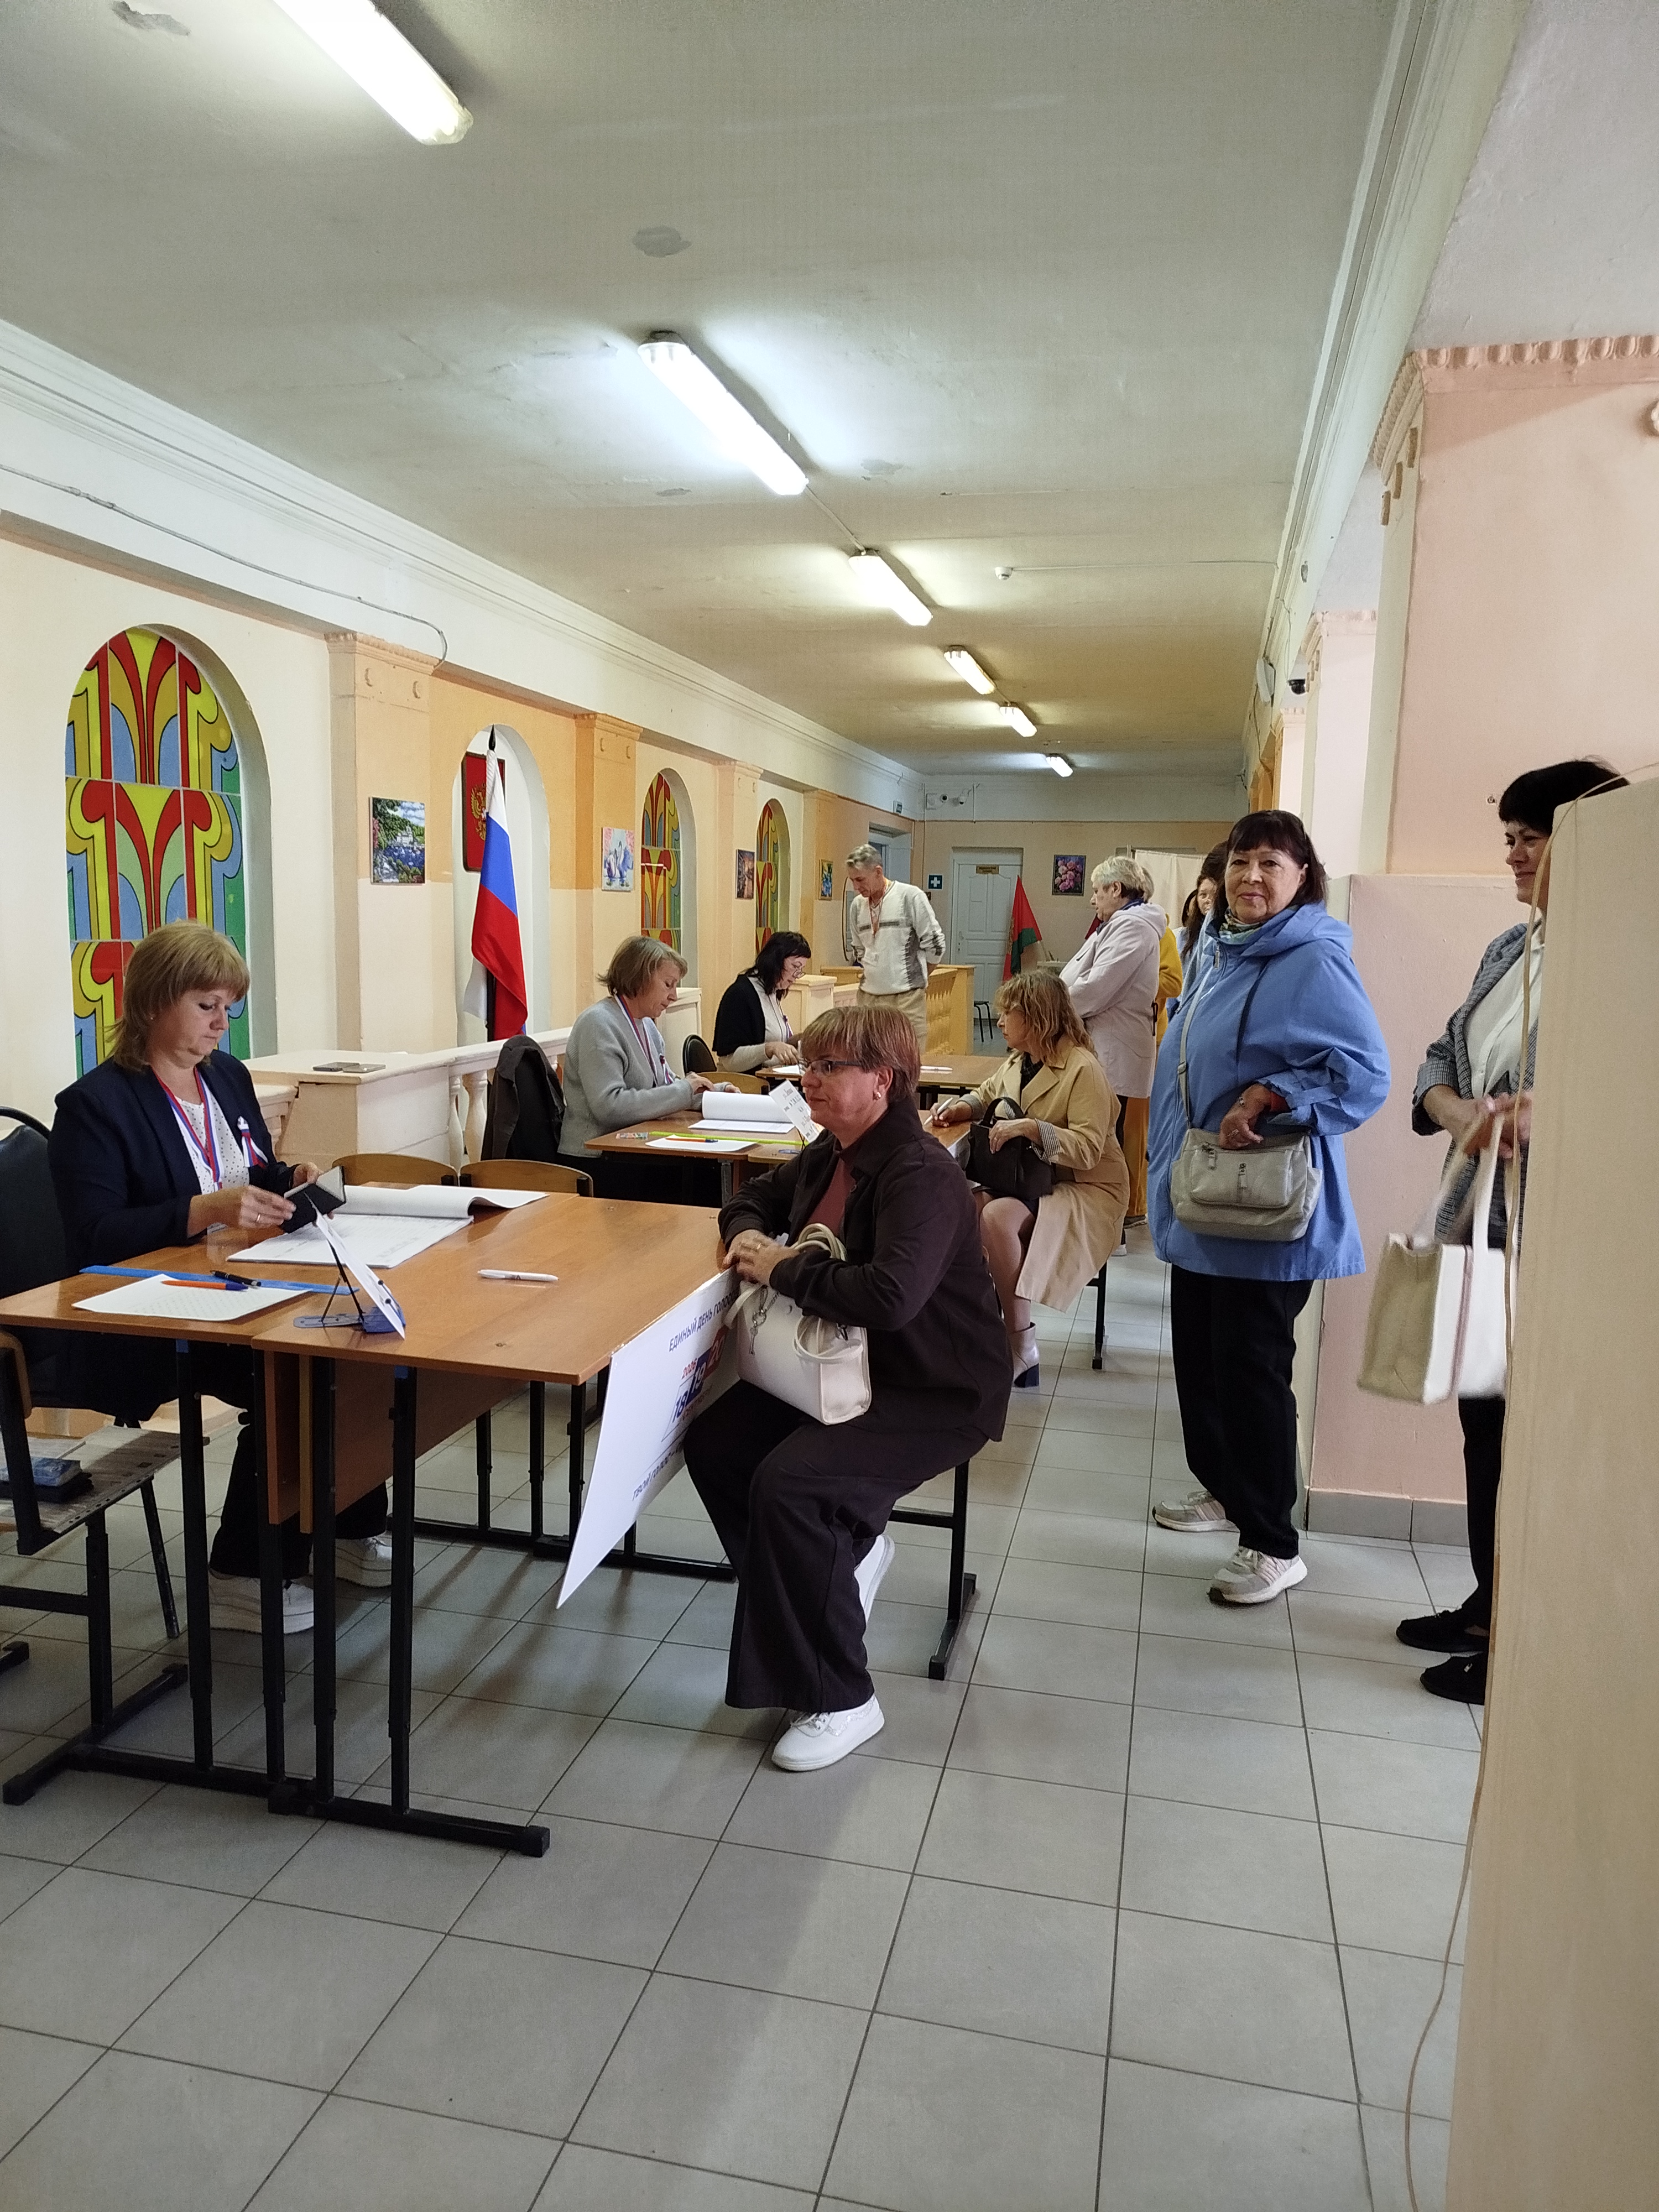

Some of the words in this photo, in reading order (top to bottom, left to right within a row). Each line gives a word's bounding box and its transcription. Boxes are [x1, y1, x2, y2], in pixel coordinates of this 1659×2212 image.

[669, 1316, 697, 1352] ЕДИНЫЙ
[697, 1308, 713, 1332] ДЕНЬ
[672, 1390, 688, 1423] 18
[691, 1361, 706, 1394] 19
[707, 1334, 726, 1369] 20
[681, 1358, 697, 1380] 2026
[632, 1470, 651, 1501] ТВОЙ
